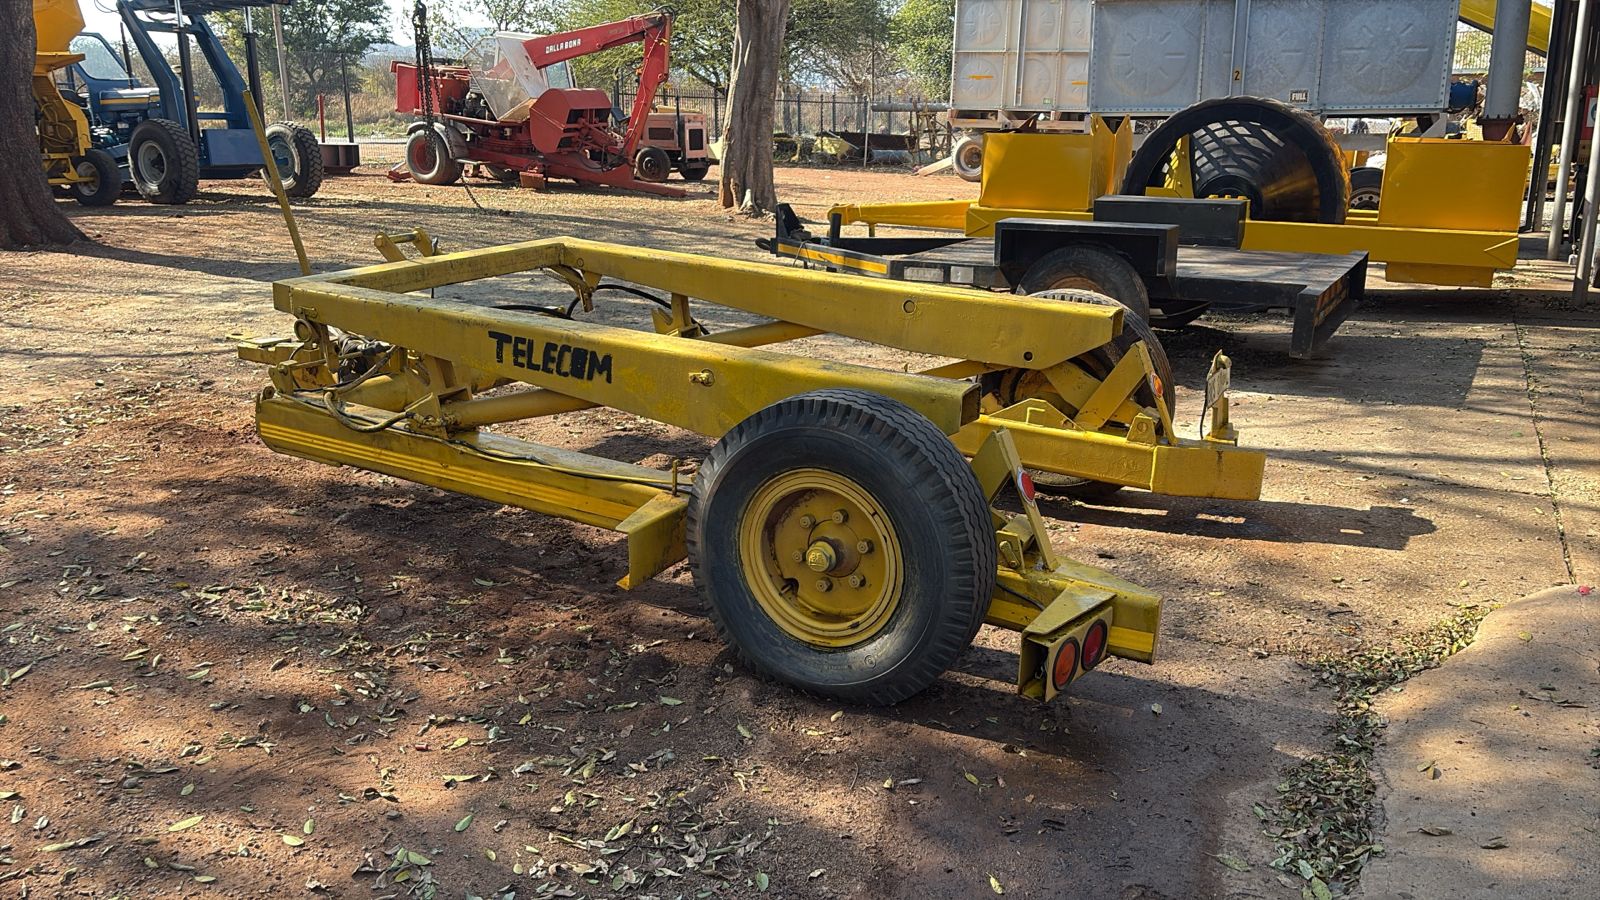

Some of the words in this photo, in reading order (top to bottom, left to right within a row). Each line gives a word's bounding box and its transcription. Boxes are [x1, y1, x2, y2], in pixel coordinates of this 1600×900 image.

[1234, 70, 1240, 81] 2
[1291, 92, 1307, 101] FULL
[488, 331, 612, 384] TELECOM
